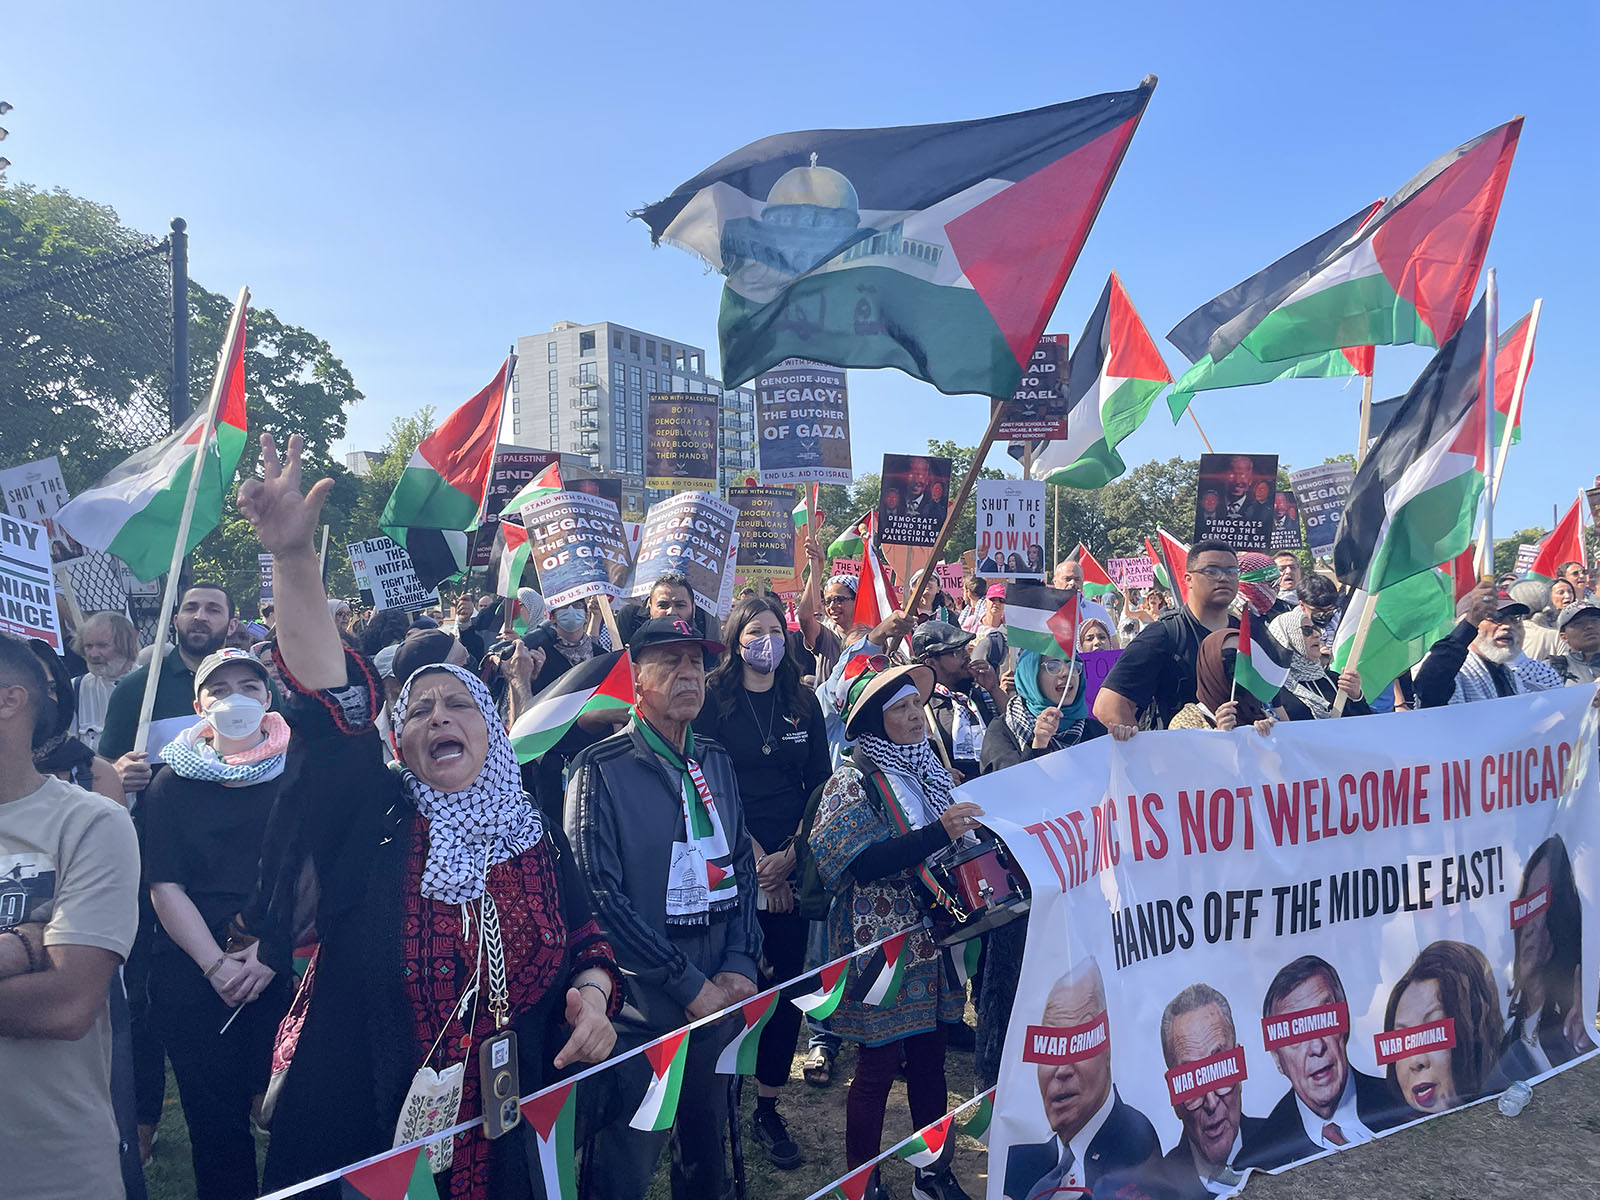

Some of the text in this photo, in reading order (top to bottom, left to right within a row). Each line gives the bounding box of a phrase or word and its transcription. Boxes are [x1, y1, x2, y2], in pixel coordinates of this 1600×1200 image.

[1028, 364, 1056, 372] AID
[761, 376, 840, 386] GENOCIDE JOE'S
[1022, 378, 1039, 386] TO
[762, 388, 842, 404] LEGACY:
[1014, 391, 1057, 399] RAEL
[672, 406, 694, 414] BOTH
[763, 409, 844, 420] THE BUTCHER
[655, 418, 702, 426] DEMOCRATS
[656, 430, 709, 438] REPUBLICANS
[764, 424, 846, 440] OF GAZA
[496, 470, 533, 480] END
[9, 477, 62, 503] SHUT THE
[1297, 479, 1334, 490] GENOCIDE
[525, 494, 616, 512] STAND WITH PALESTINE
[674, 494, 693, 502] WITH
[695, 495, 734, 516] PALESTINE
[982, 499, 1040, 511] SHUT THE
[1304, 500, 1346, 514] THE BUTC
[532, 507, 615, 524] GENOCIDE JOE'S
[650, 506, 726, 527] GENOCIDE JOE'S
[740, 510, 780, 518] EMOCRATS
[888, 515, 938, 524] DEMOCRATS
[1307, 515, 1326, 527] OF
[533, 517, 621, 540] LEGACY:
[646, 516, 724, 544] LEGACY:
[1206, 519, 1263, 528] DEMOCRATS
[882, 534, 936, 543] PALESTINIAN
[884, 528, 926, 537] GENOCIDE
[363, 539, 400, 554] GLOBA
[538, 534, 625, 554] THE BUTCHER
[642, 537, 664, 550] THE
[666, 532, 722, 557] BUTCHER
[982, 531, 1039, 551] DOWN!
[1228, 541, 1267, 549] TINIANS
[385, 549, 405, 560] THE
[542, 546, 629, 570] OF GAZA
[637, 548, 662, 564] OF
[666, 544, 718, 574] GAZA
[374, 558, 414, 576] INTIFAD
[836, 562, 851, 571] THE
[1125, 566, 1141, 575] AZA
[381, 574, 420, 590] FIGHT TH
[385, 583, 424, 598] U.S. WAR
[550, 594, 566, 606] END
[568, 589, 584, 598] U.S.
[586, 584, 600, 592] AID
[385, 591, 428, 608] MACHINE!
[694, 595, 712, 609] RAEL
[1023, 810, 1088, 893] THE
[1127, 793, 1169, 862] IS
[1178, 786, 1254, 855] NOT
[1262, 765, 1430, 846] WELCOME
[1441, 759, 1471, 821] IN
[1481, 738, 1577, 813] CHICAG
[1111, 895, 1194, 970] HANDS
[1203, 889, 1263, 944] OFF
[1272, 878, 1322, 936] THE
[1329, 860, 1433, 924] MIDDLE
[1442, 846, 1504, 906] EAST!
[1267, 1010, 1339, 1041] WAR CRIMINAL
[1033, 1022, 1106, 1056] WAR CRIMINAL
[1380, 1027, 1448, 1056] WAR CRIMINAL
[1172, 1056, 1239, 1094] WAR CRIMINAL
